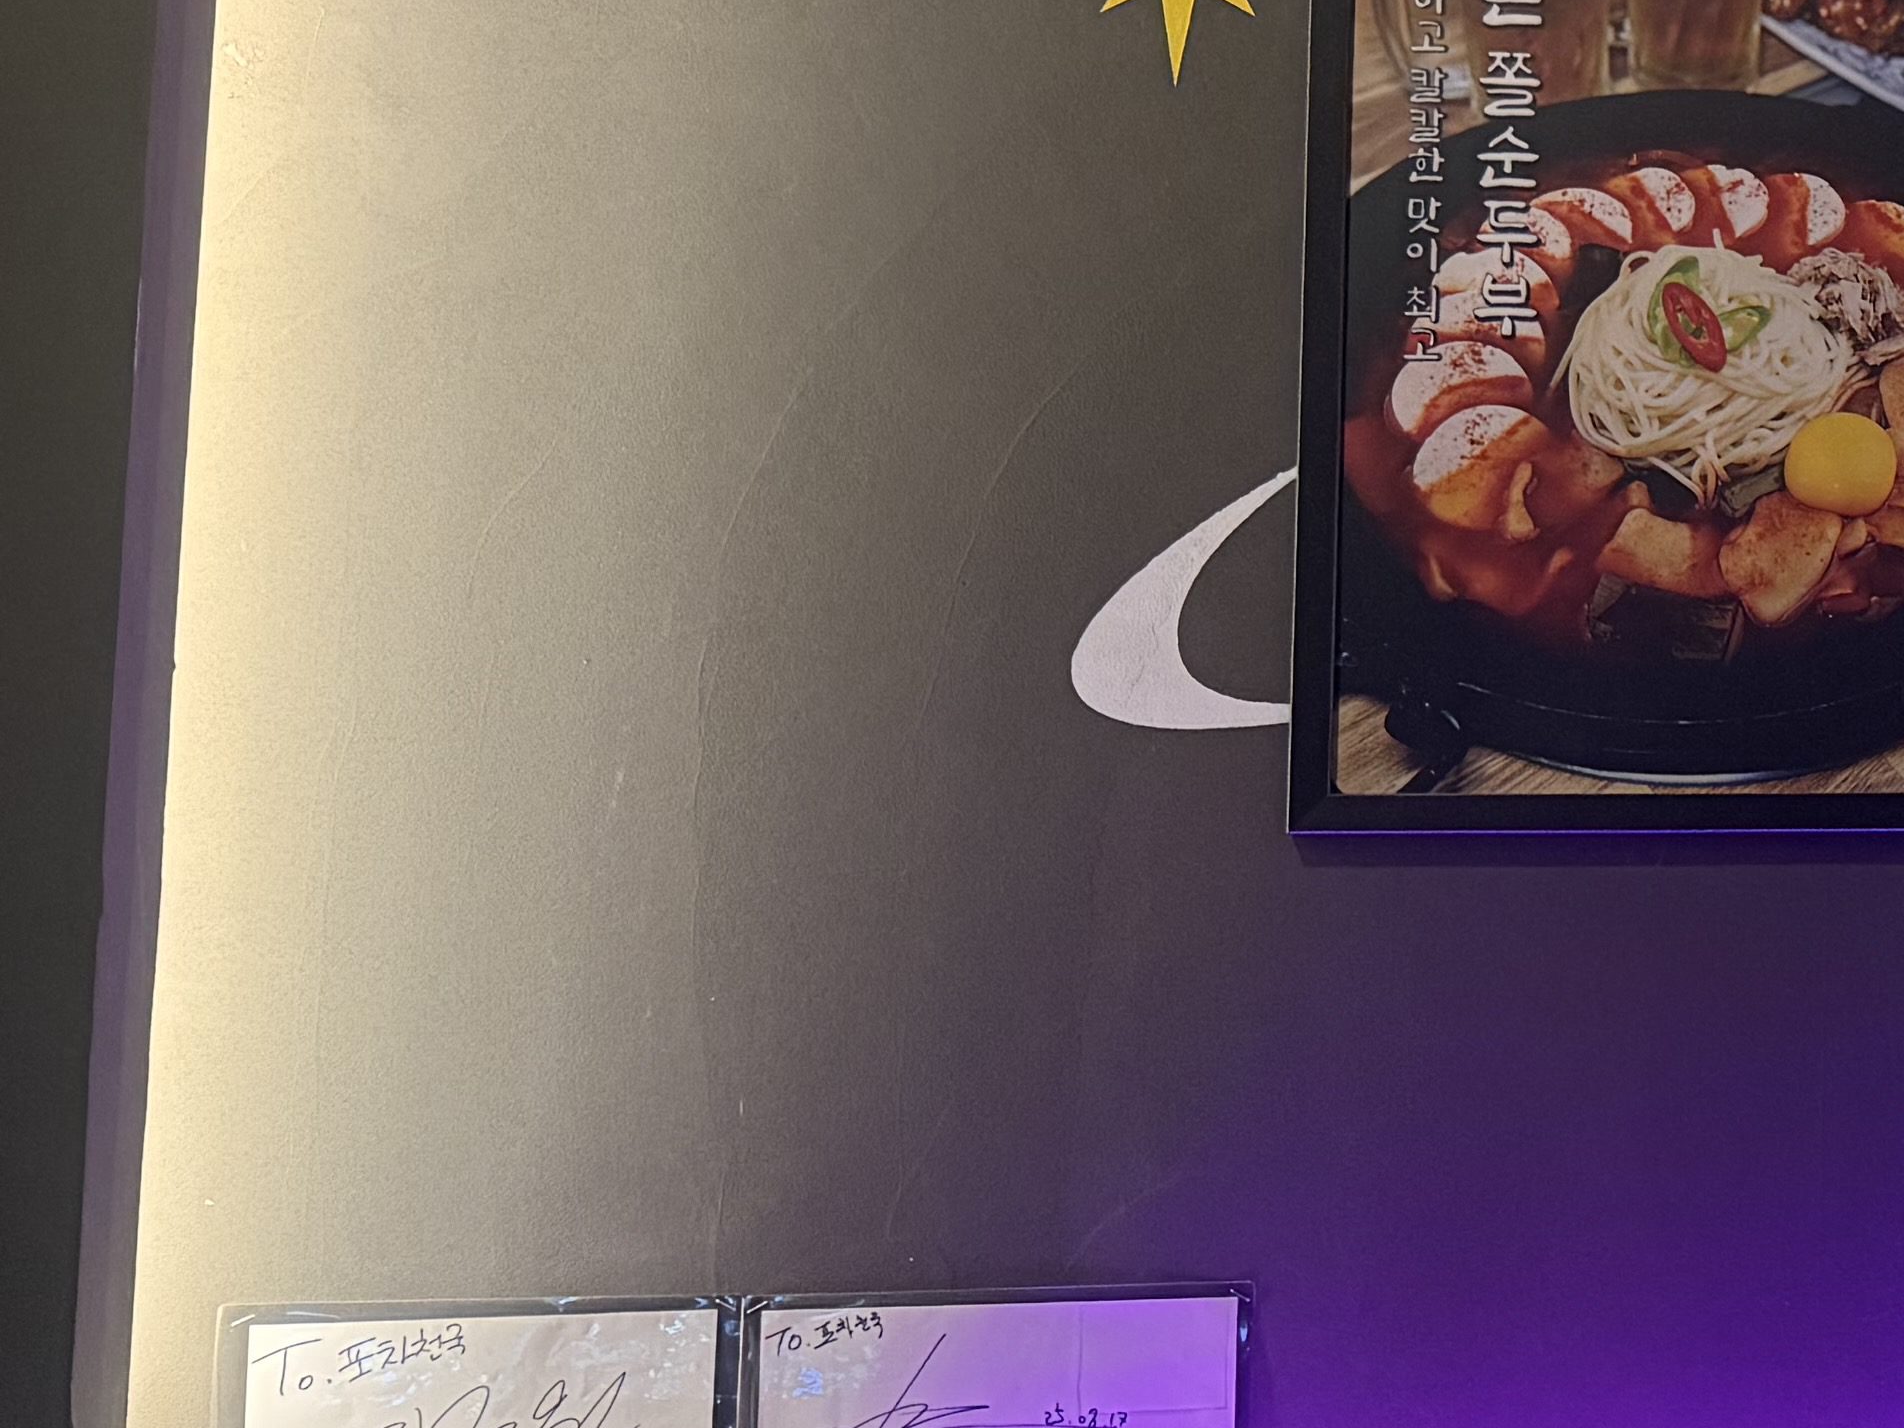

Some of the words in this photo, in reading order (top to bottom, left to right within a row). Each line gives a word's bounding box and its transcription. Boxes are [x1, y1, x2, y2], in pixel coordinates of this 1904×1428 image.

[1408, 67, 1447, 183] 칼칼한
[1405, 196, 1442, 272] 맛이
[1473, 52, 1542, 337] 쫄순두부
[1403, 284, 1441, 360] 최고
